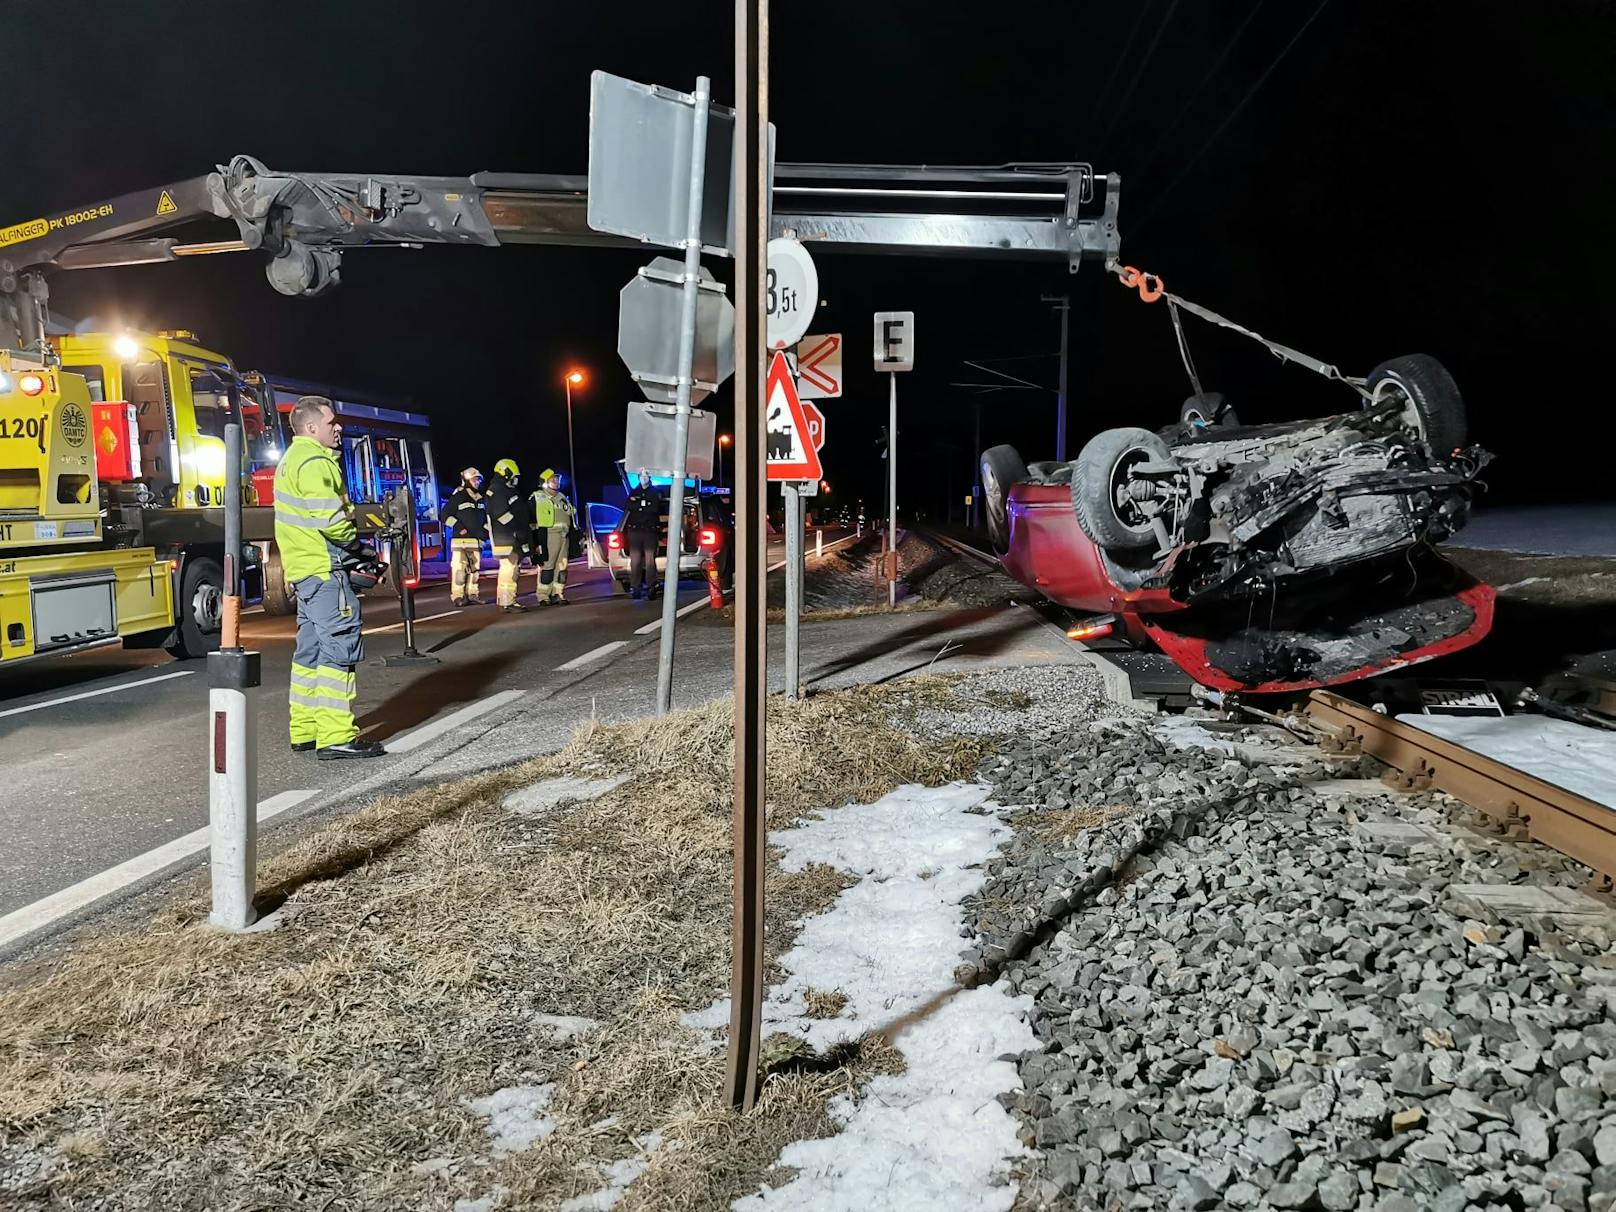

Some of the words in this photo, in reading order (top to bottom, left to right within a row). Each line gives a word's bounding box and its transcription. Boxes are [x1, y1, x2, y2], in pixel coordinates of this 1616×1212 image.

[49, 219, 64, 230] PK
[64, 204, 114, 226] 18002-EH
[883, 320, 904, 363] E
[0, 418, 39, 438] 120
